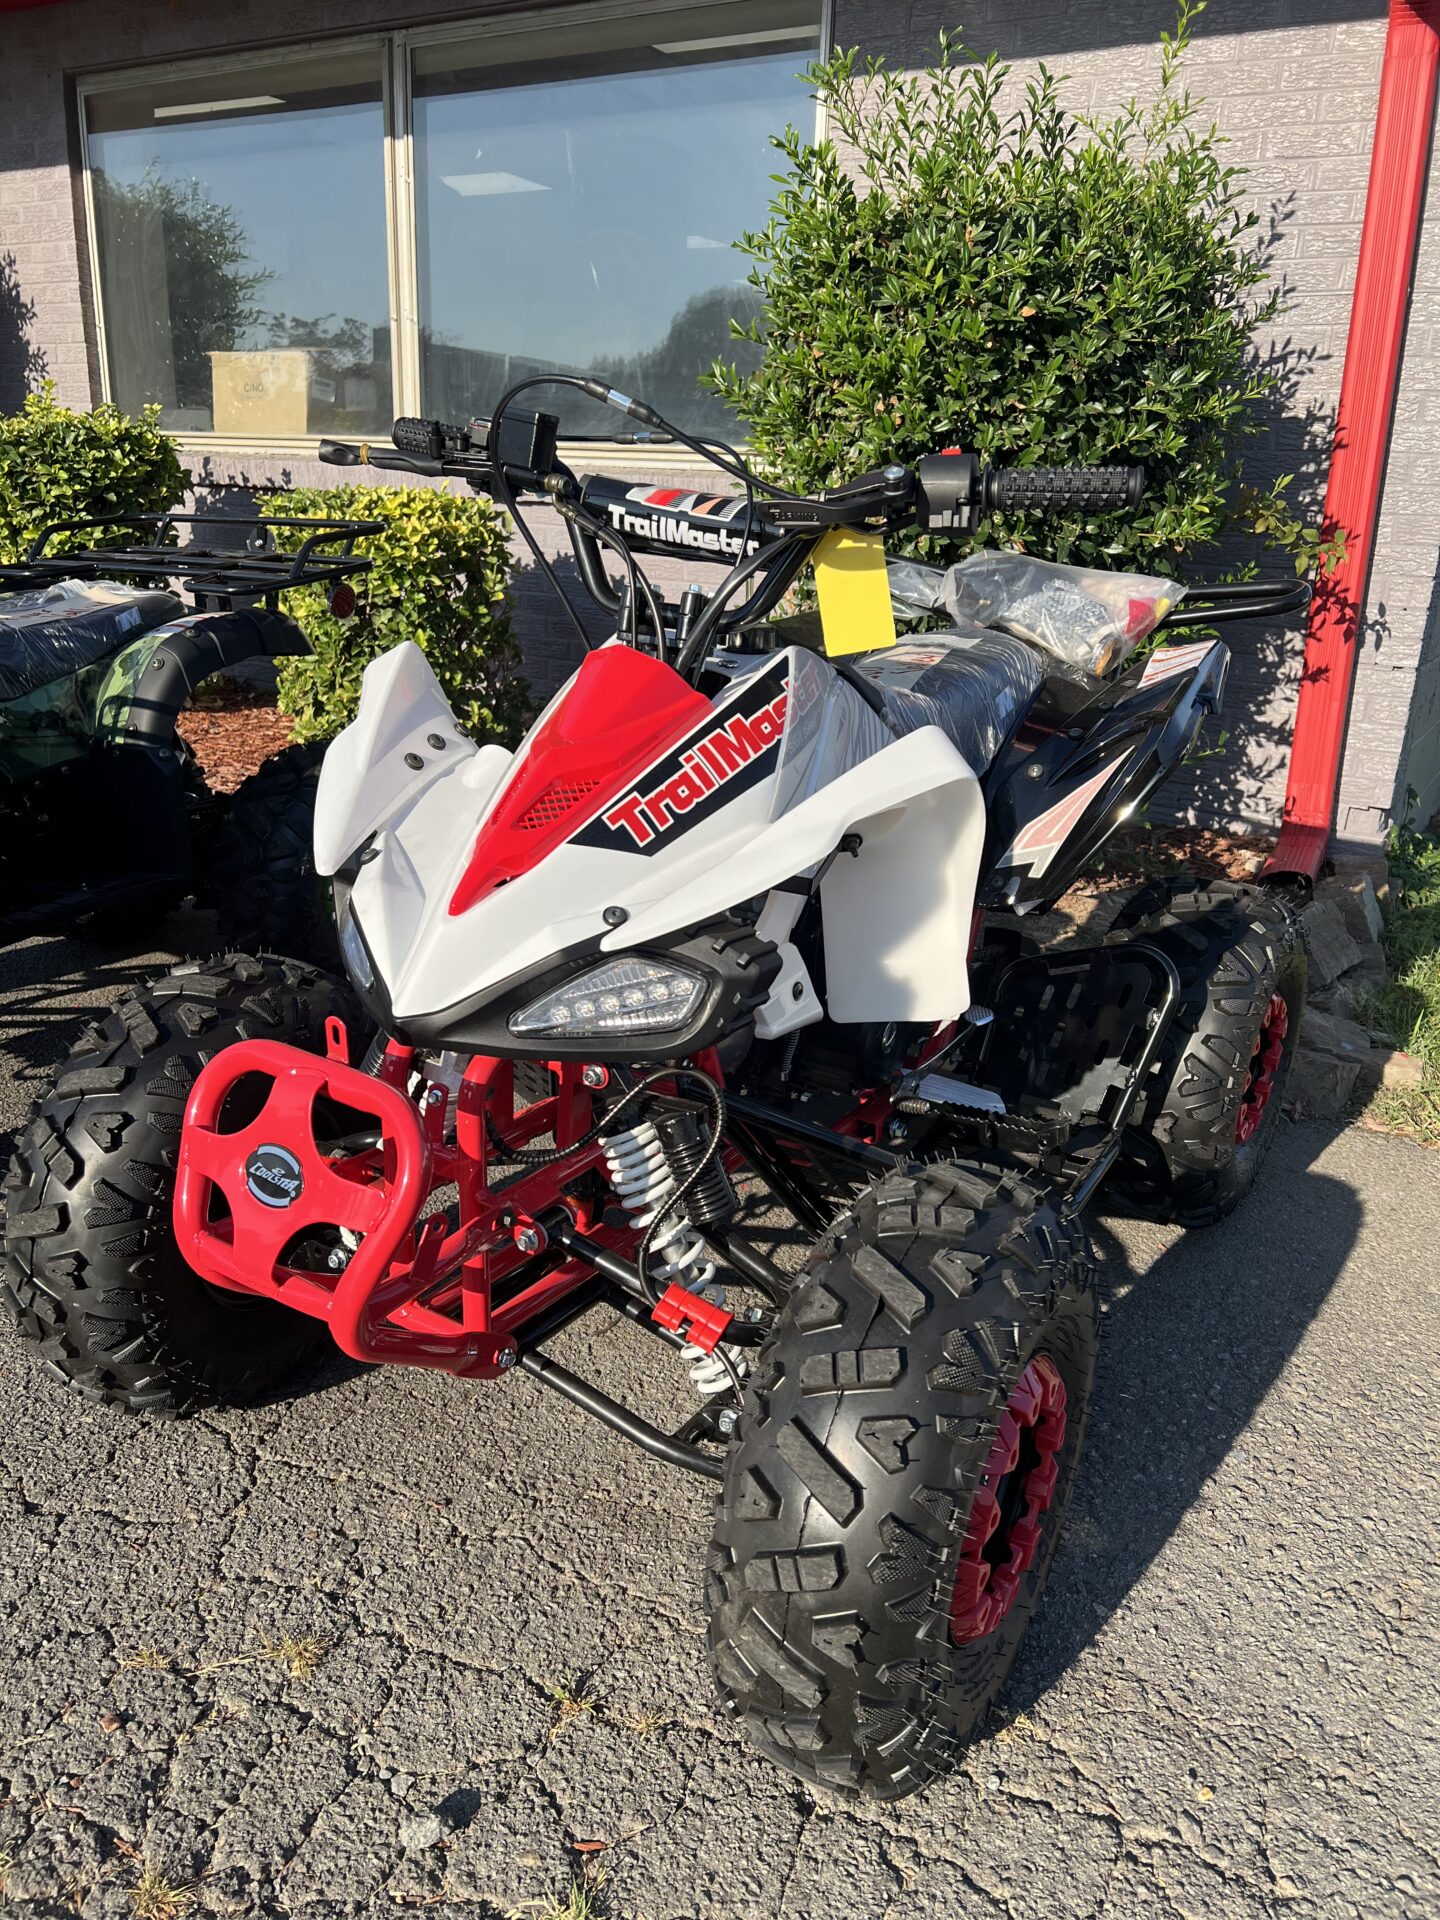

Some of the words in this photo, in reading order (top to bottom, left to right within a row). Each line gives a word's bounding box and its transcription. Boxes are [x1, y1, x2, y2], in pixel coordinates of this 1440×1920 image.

[607, 503, 760, 556] TrailMaster
[602, 659, 820, 847] TrailMaster
[249, 1162, 300, 1192] COOLSTER
